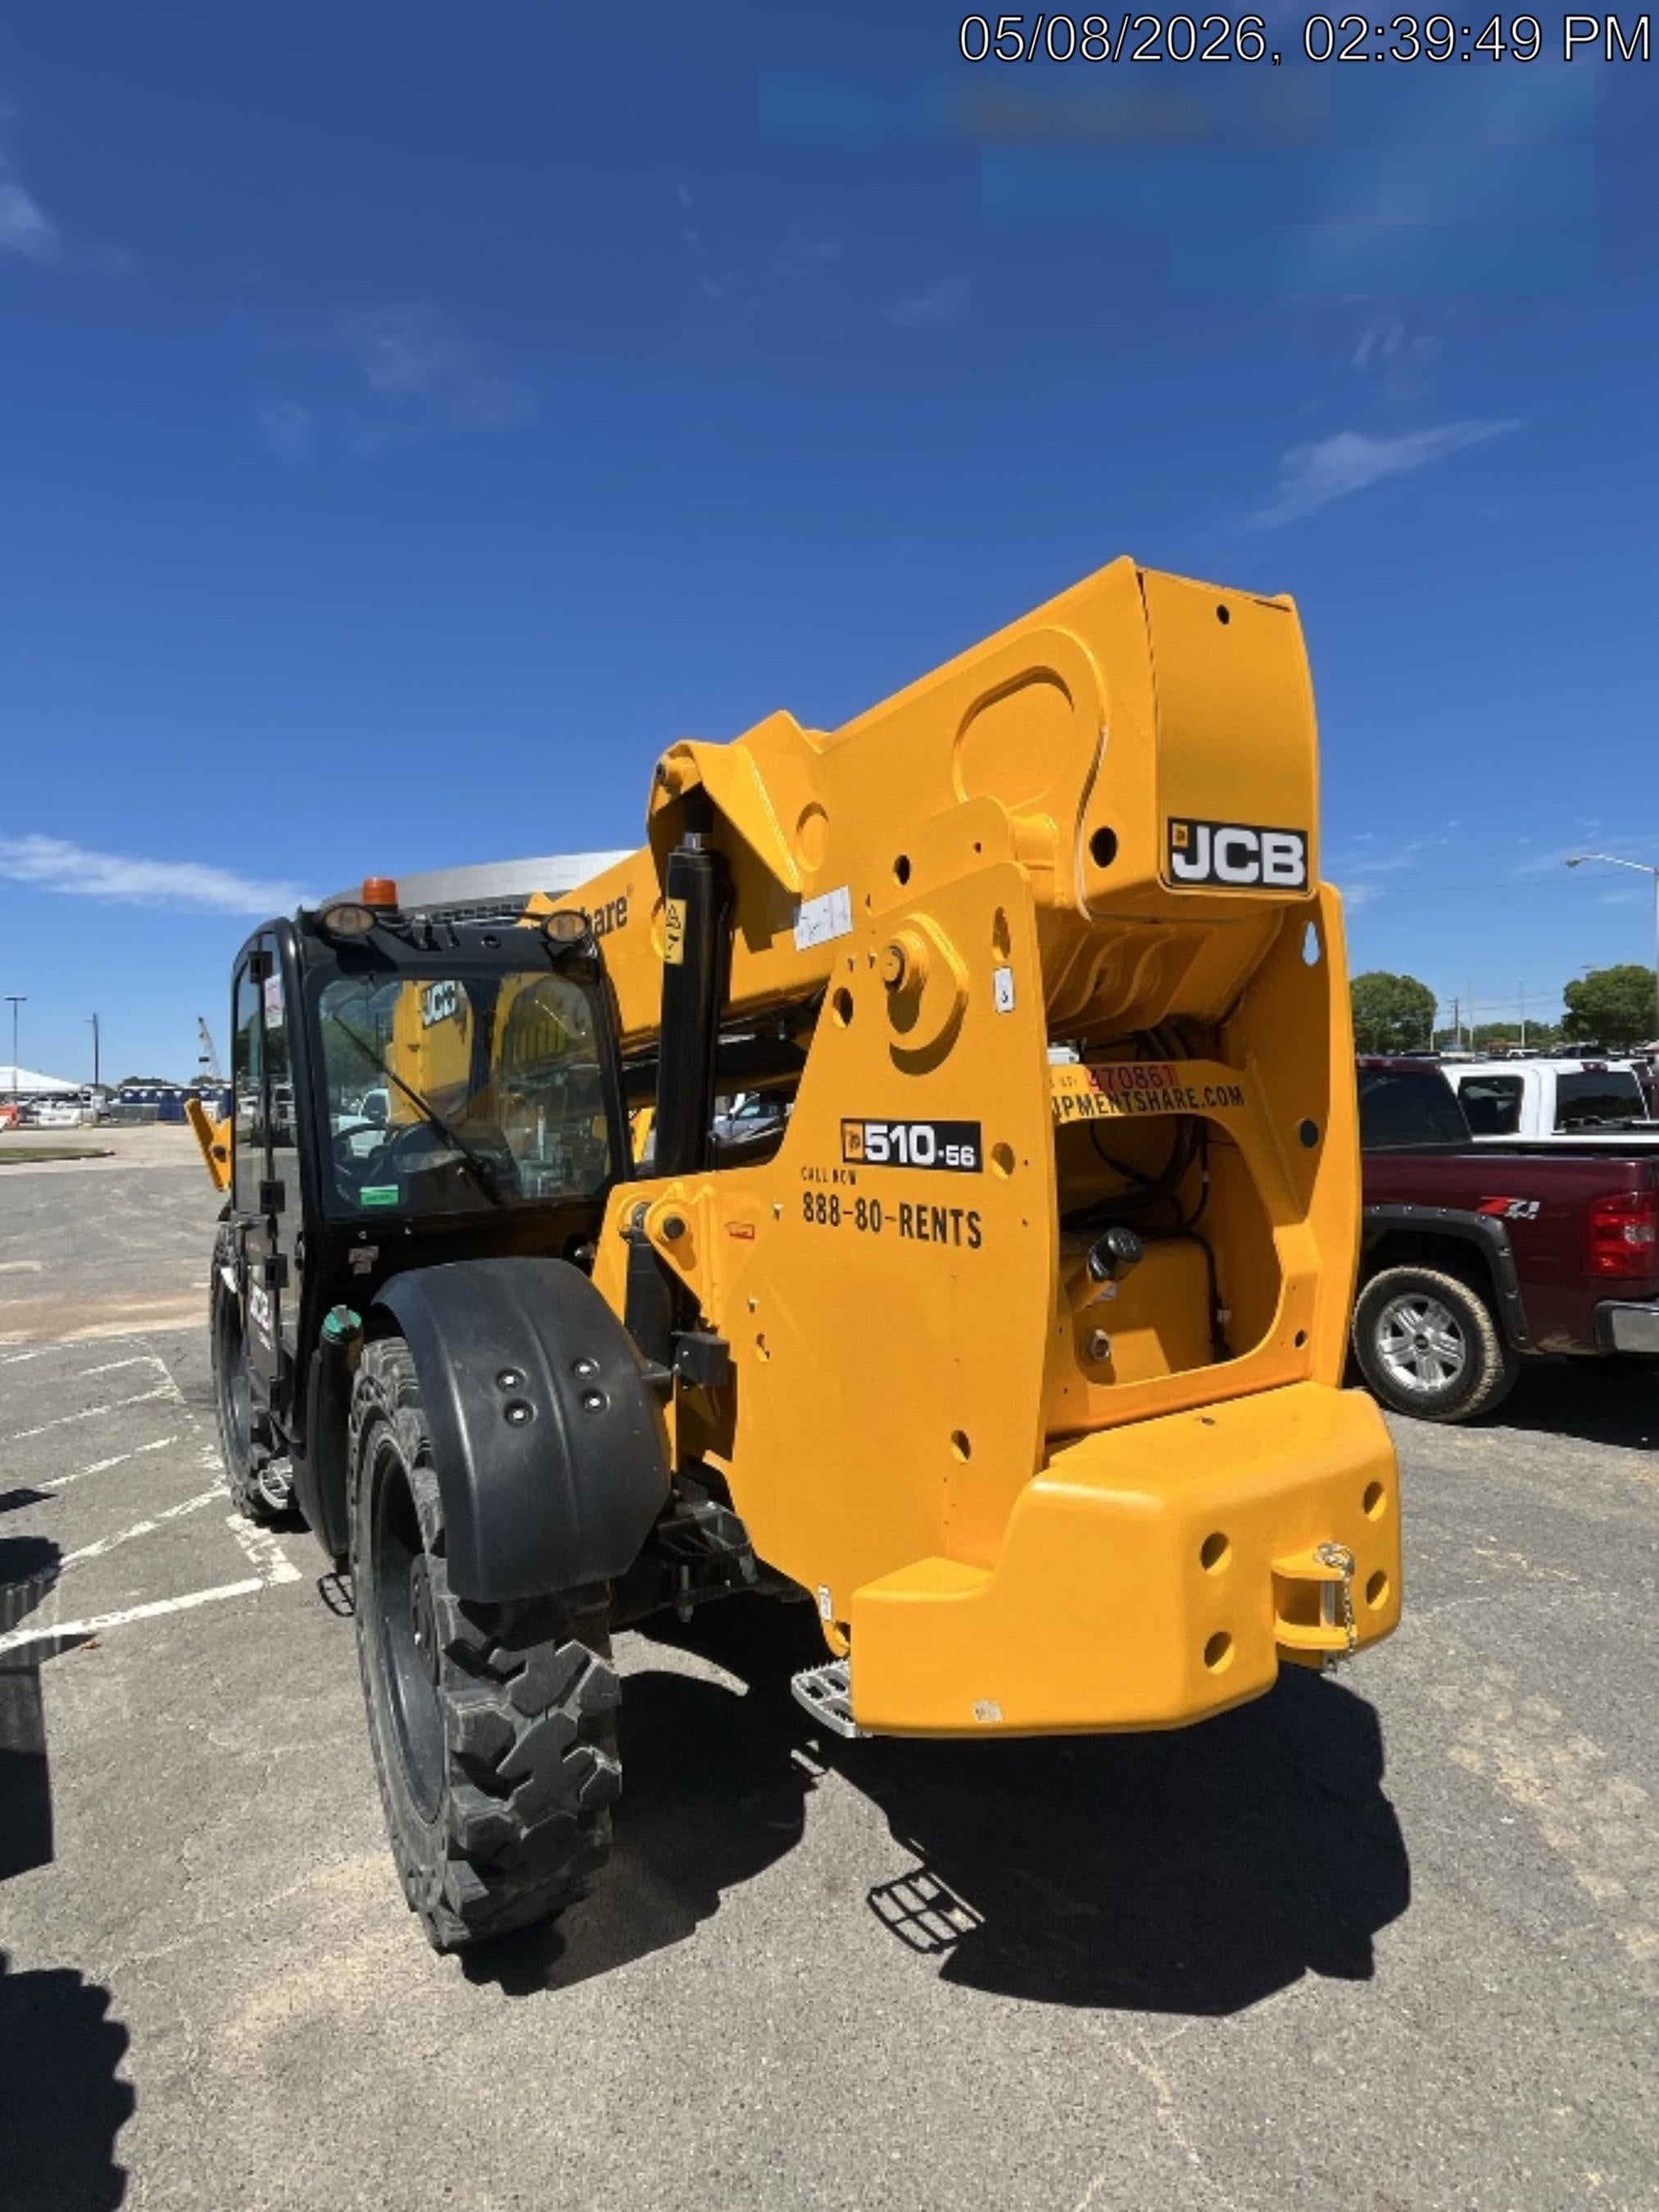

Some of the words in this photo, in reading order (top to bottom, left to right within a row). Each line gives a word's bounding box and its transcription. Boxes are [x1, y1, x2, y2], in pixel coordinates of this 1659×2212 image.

[1172, 825, 1305, 885] JCB
[800, 1166, 828, 1183] CALL
[802, 1191, 982, 1249] 888-80-RENTS
